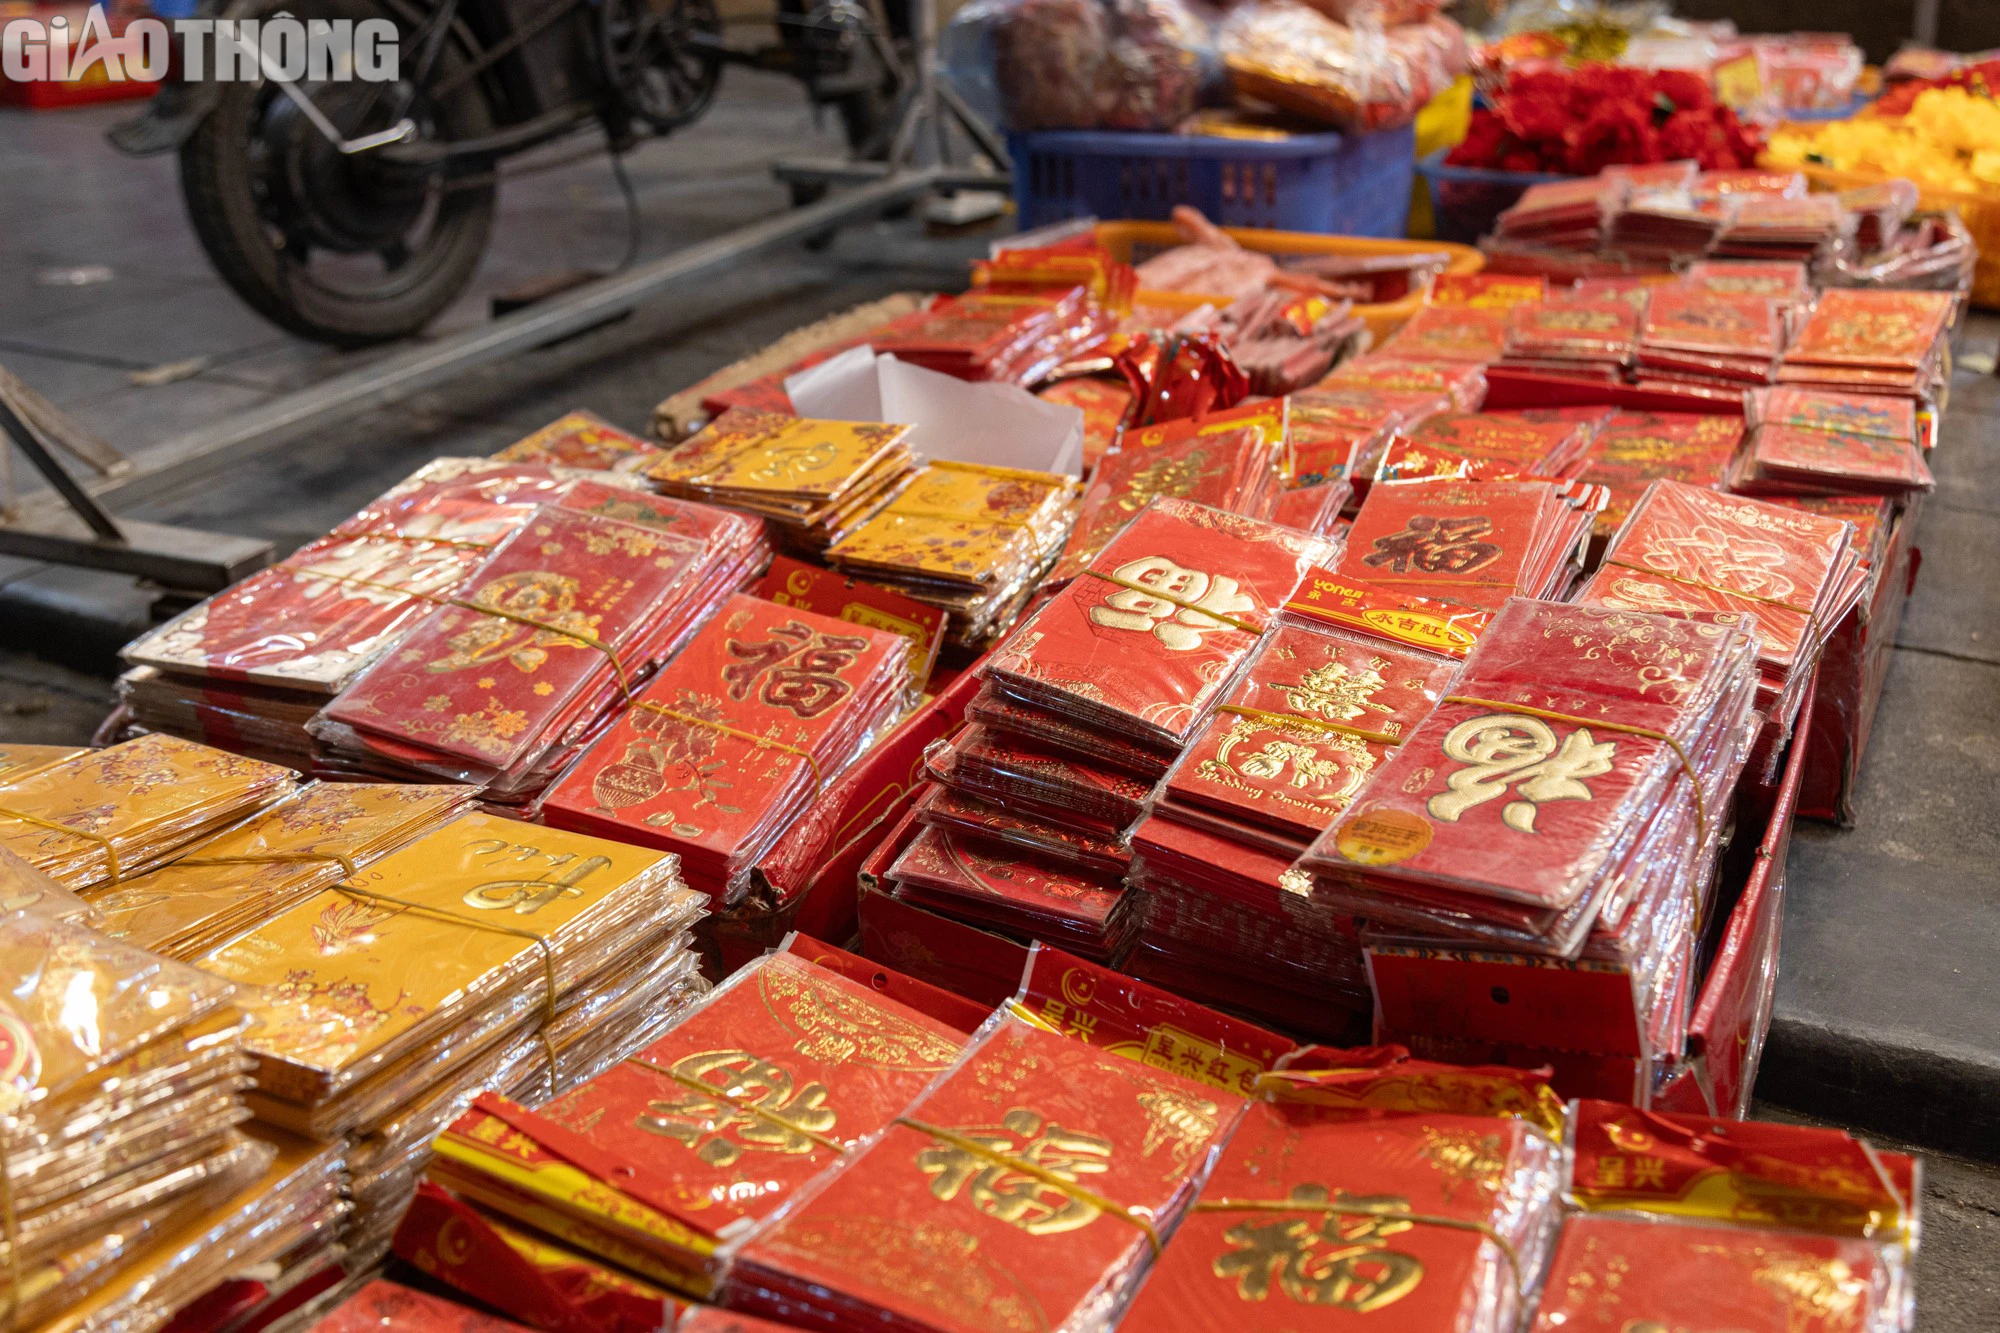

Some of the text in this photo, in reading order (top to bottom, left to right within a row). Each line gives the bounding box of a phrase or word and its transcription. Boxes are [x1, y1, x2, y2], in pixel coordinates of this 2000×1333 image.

[1361, 514, 1503, 574] 福
[1642, 524, 1795, 601] 福
[1090, 556, 1255, 650] 福
[720, 619, 871, 720] 福
[1271, 791, 1340, 817] Invitatio
[1426, 712, 1617, 835] 福
[633, 1049, 838, 1168] 福
[915, 1106, 1114, 1236] 福
[1213, 1183, 1425, 1313] 福
